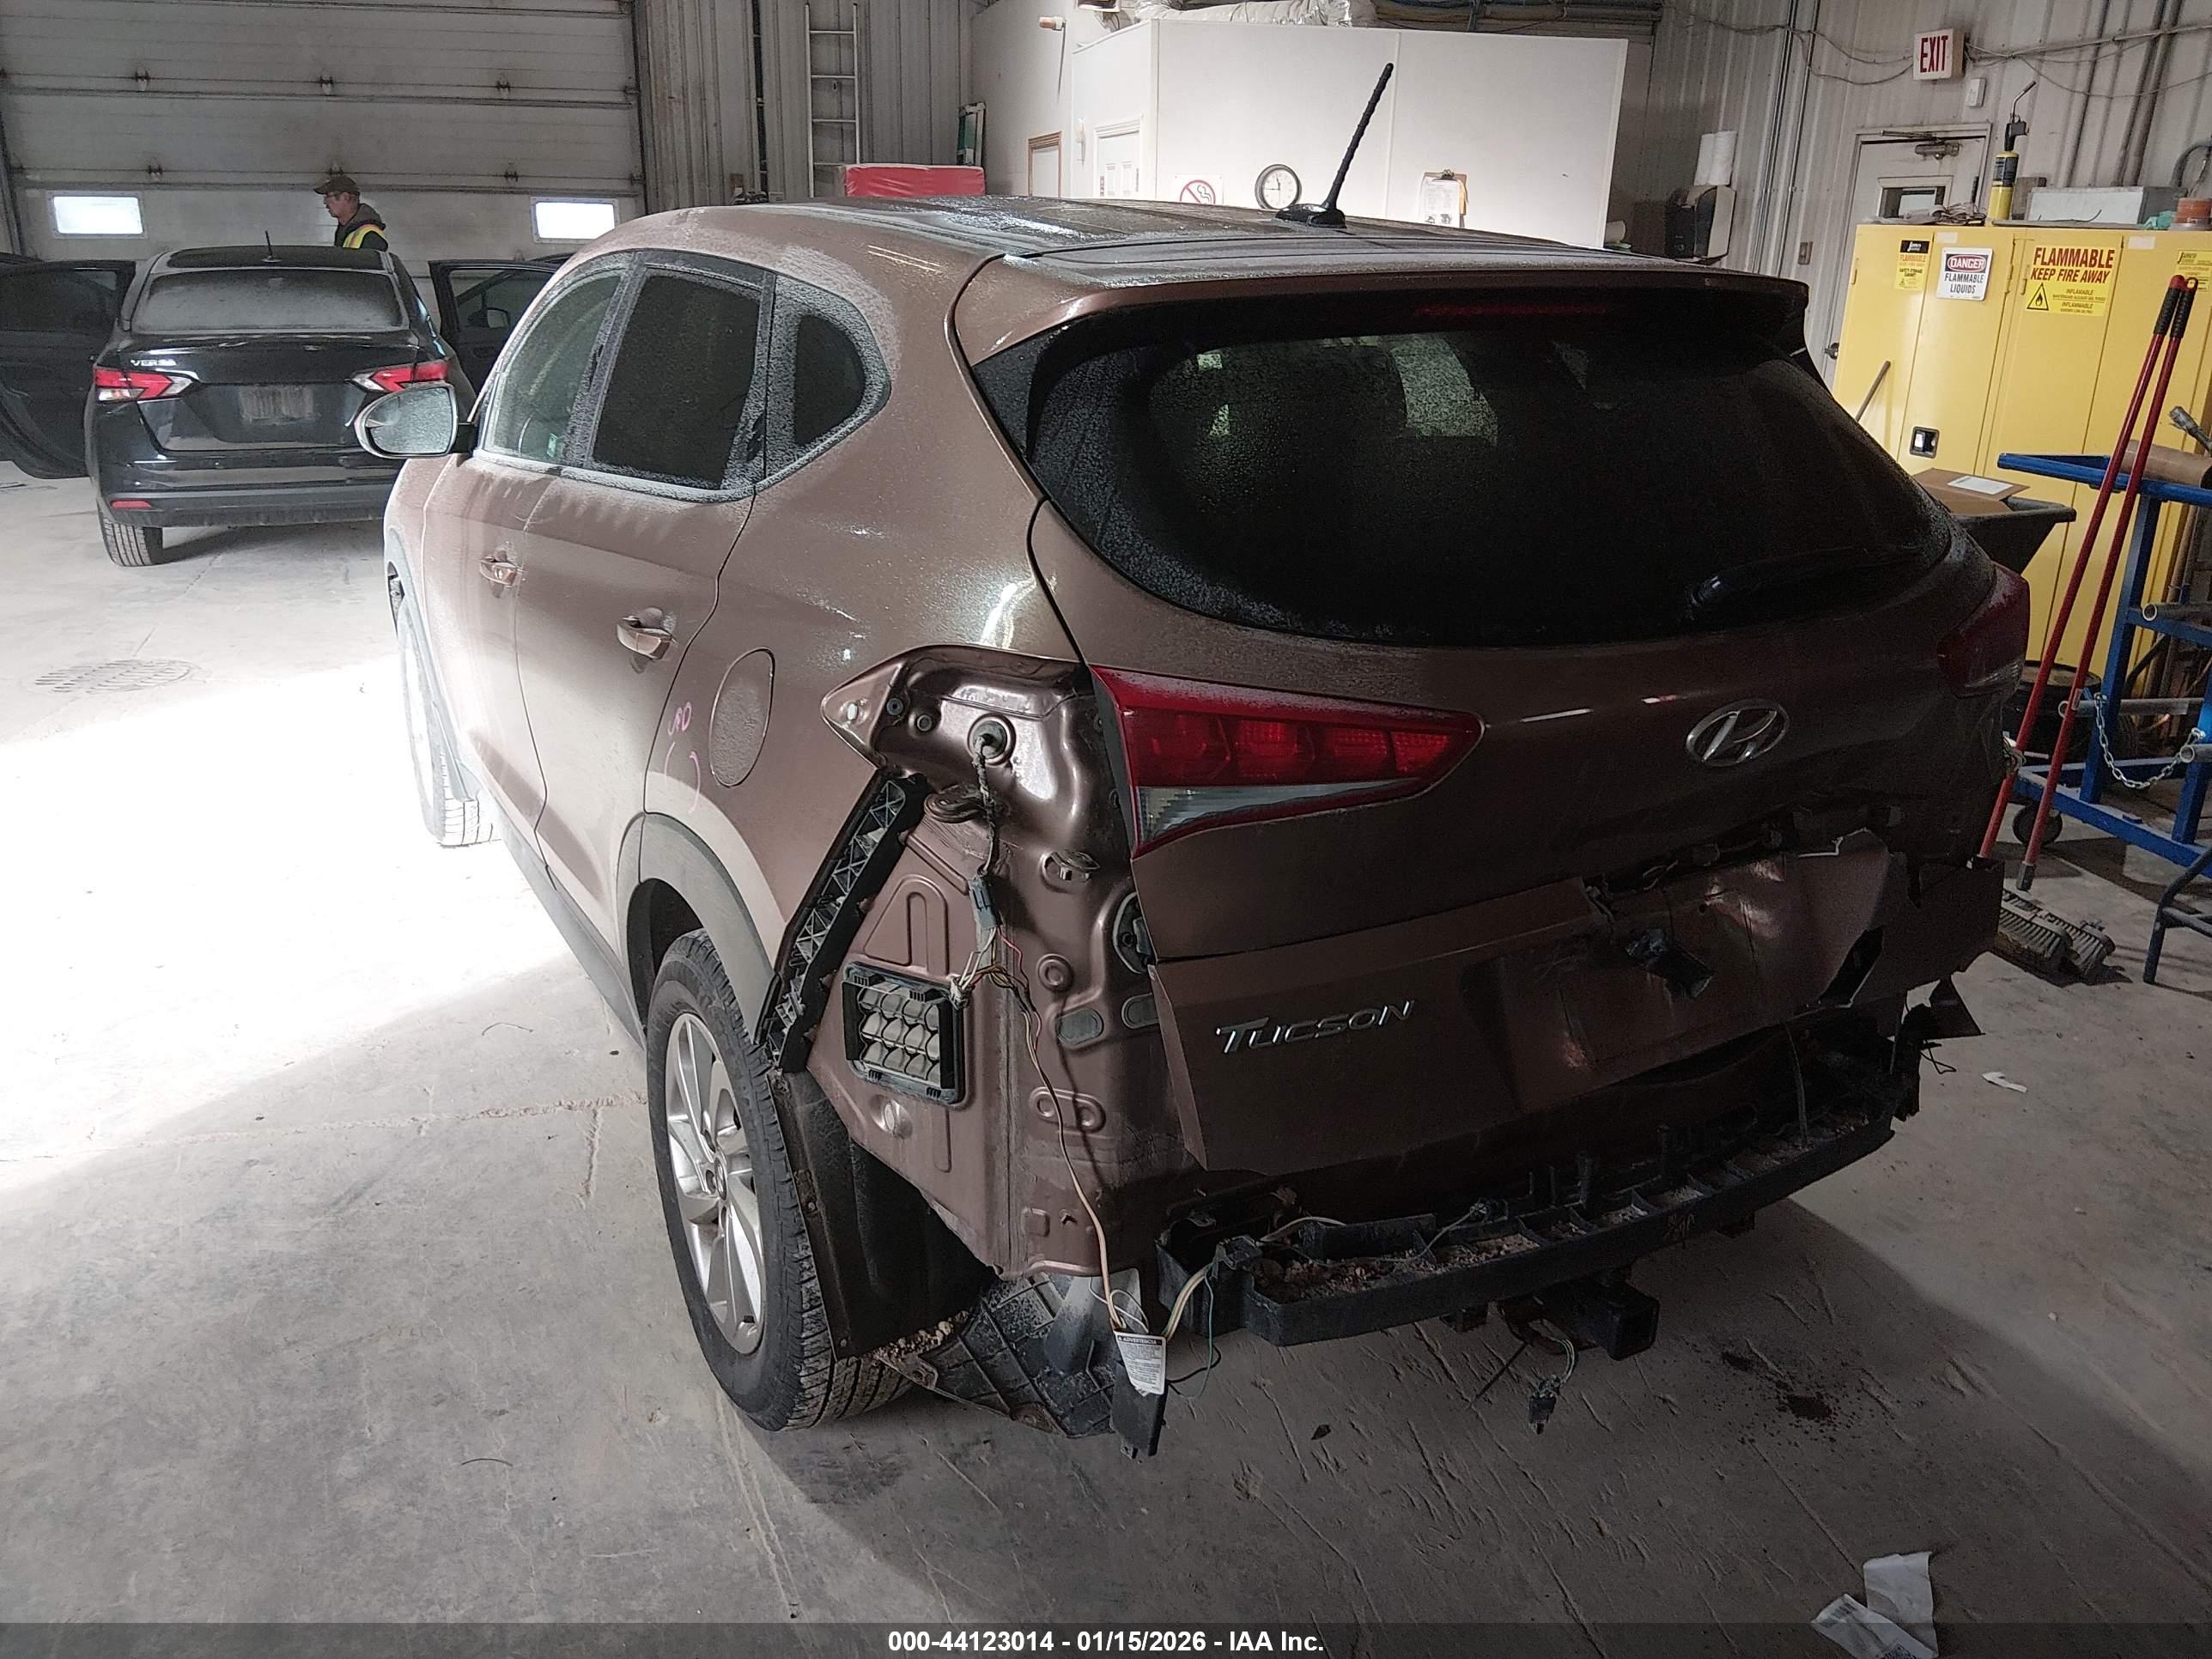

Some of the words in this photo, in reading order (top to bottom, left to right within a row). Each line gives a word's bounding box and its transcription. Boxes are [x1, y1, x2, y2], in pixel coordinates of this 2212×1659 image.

[1919, 35, 1948, 73] EXIT
[1950, 258, 1984, 269] DANGER
[2033, 247, 2116, 269] FLAMMABLE
[1944, 273, 1984, 283] FLAMMABLE
[2030, 267, 2056, 282] KEEP
[2057, 269, 2081, 283] FIRE
[2080, 270, 2111, 284] AWAY
[1950, 284, 1976, 294] LIQUIDS
[1216, 999, 1415, 1054] TUCSON
